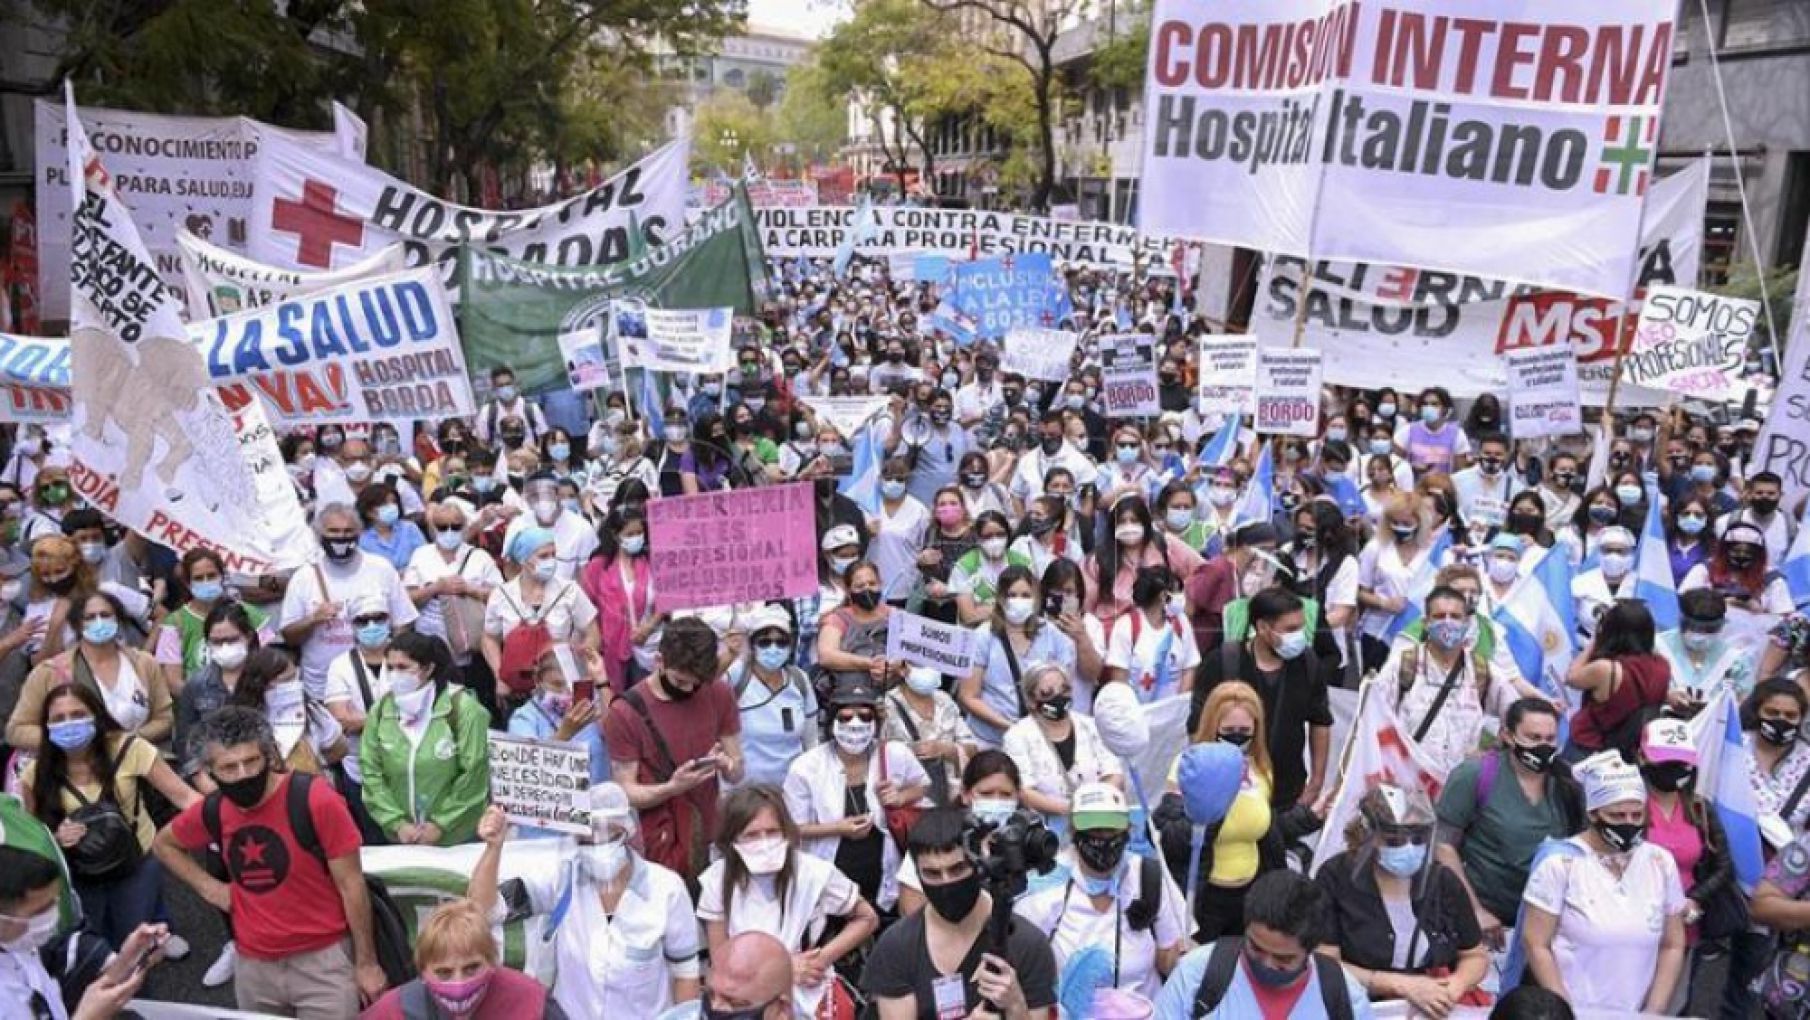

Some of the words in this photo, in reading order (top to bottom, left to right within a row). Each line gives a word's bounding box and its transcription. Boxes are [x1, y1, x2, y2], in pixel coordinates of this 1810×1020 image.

[1371, 8, 1672, 106] INTERNA
[60, 127, 240, 160] CONOCIMIENTO
[1154, 93, 1320, 174] Hospital
[1322, 89, 1588, 190] Italiano
[115, 174, 172, 195] PARA
[373, 167, 645, 243] HOSPAL
[470, 250, 626, 291] HOSPITAL
[628, 198, 740, 277] DURAND
[893, 210, 1001, 231] CONTRA
[404, 215, 666, 291] POADAS
[207, 319, 271, 378] LA
[275, 280, 438, 366] SALUD
[1267, 275, 1460, 338] SALUD
[1504, 302, 1632, 355] MST
[1645, 294, 1755, 336] SOMOS
[253, 361, 351, 414] YA!
[353, 348, 461, 386] HOSPITAL
[1258, 403, 1315, 421] BORDO
[654, 537, 787, 572] PROFESIONAL
[920, 624, 953, 646] SOMOS
